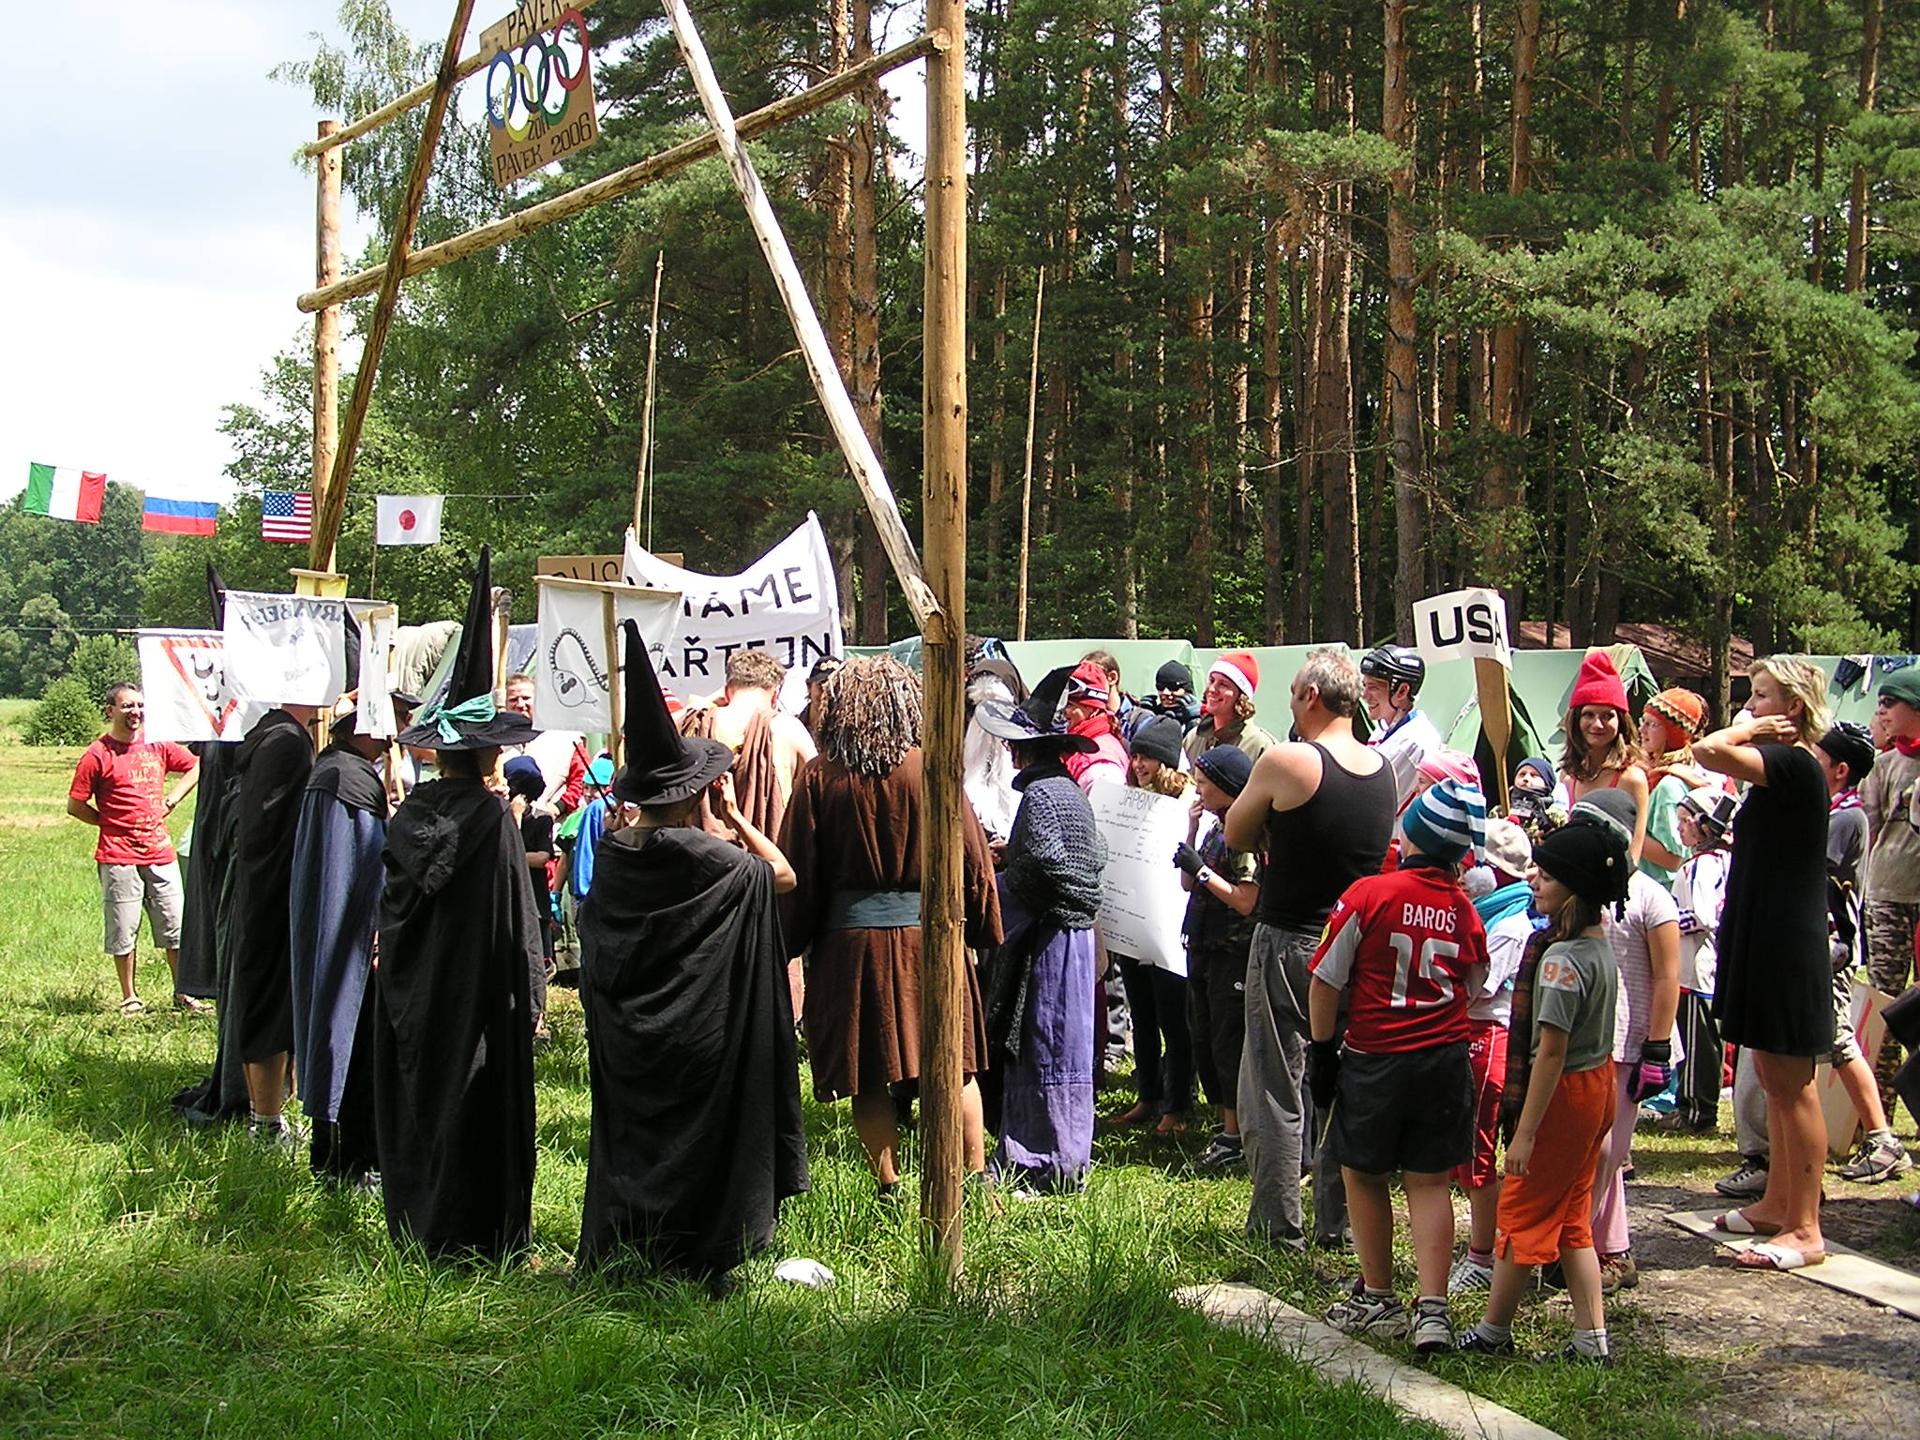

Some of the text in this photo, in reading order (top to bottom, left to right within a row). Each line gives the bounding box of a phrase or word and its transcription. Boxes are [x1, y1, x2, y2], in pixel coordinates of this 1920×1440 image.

[551, 112, 592, 156] 2006
[1429, 604, 1506, 652] USA
[1402, 903, 1458, 934] BAROŠ
[1389, 932, 1460, 1009] 15
